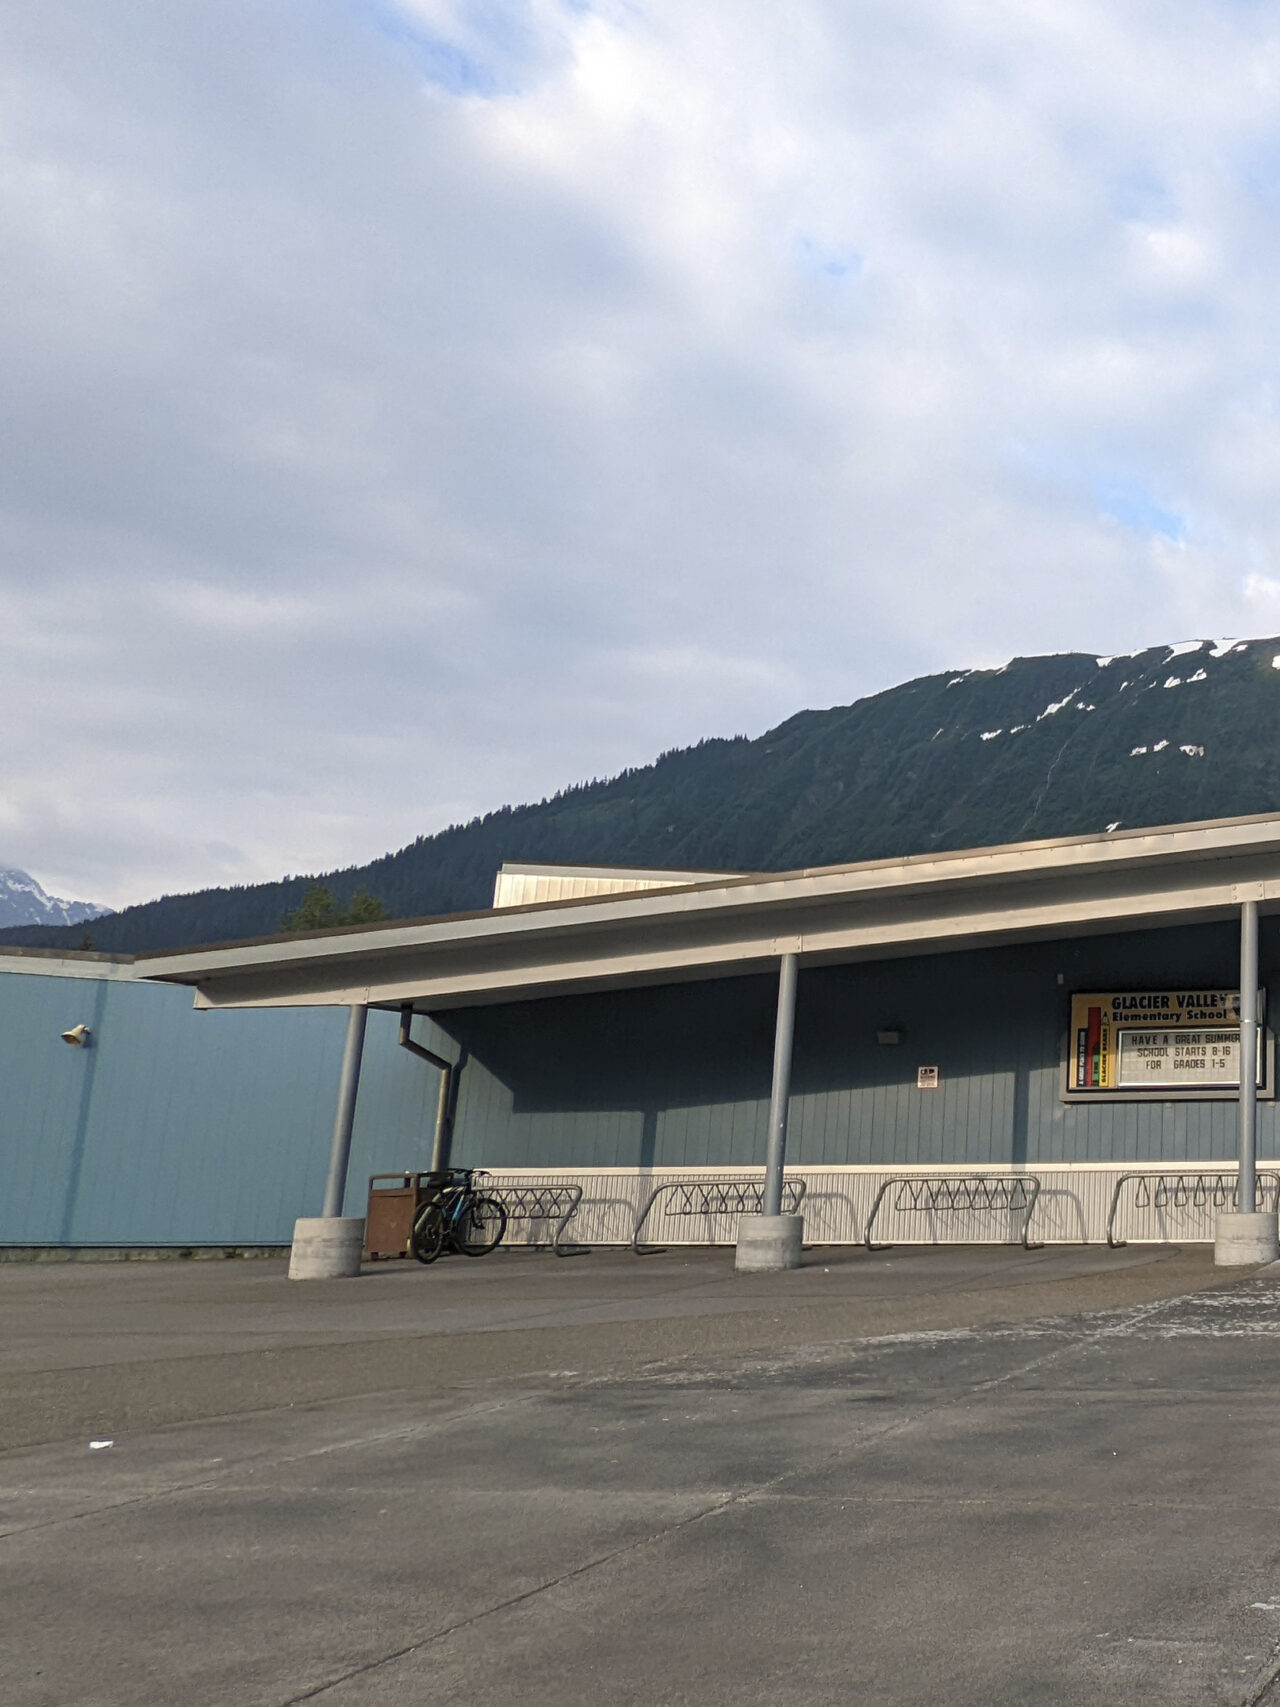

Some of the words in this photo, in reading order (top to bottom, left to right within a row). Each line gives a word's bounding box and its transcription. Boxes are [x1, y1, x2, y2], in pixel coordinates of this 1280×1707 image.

[1112, 996, 1170, 1010] GLACIER
[1176, 994, 1228, 1009] VALLEY
[1112, 1012, 1182, 1022] Elementary
[1187, 1009, 1227, 1020] School
[1131, 1035, 1158, 1046] HAVE
[1162, 1035, 1169, 1045] A
[1175, 1033, 1201, 1044] GREAT
[1205, 1033, 1240, 1043] SUMMER
[1137, 1047, 1170, 1057] SCHOOL
[1174, 1046, 1207, 1056] STARTS
[1212, 1046, 1231, 1056] 8-16
[1146, 1060, 1162, 1070] FOR
[1173, 1059, 1206, 1069] GRADES
[1212, 1058, 1226, 1068] 1-5
